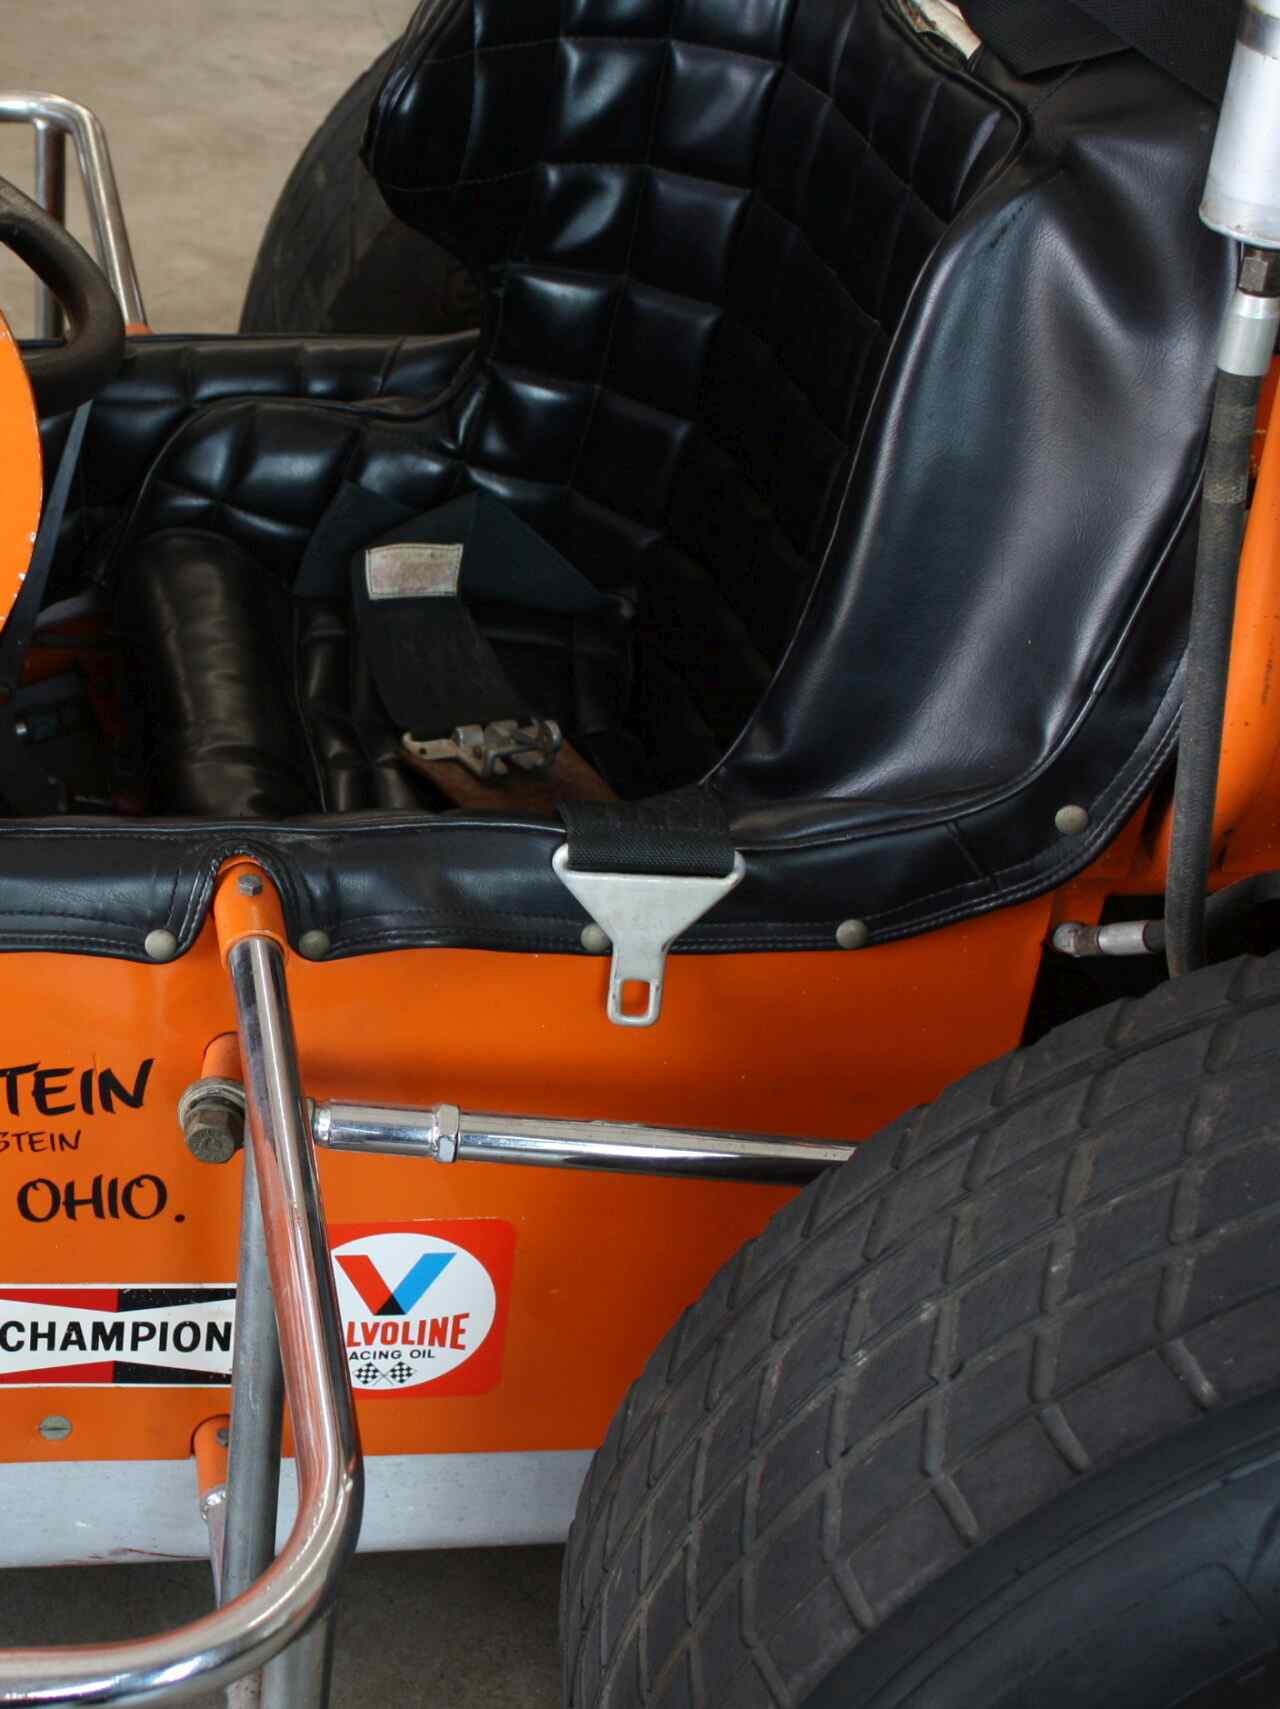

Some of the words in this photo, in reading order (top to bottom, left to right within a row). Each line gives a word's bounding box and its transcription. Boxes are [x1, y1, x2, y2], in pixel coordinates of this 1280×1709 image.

[346, 1312, 470, 1351] LVOLINE
[348, 1349, 403, 1361] ACING
[409, 1348, 437, 1360] OIL
